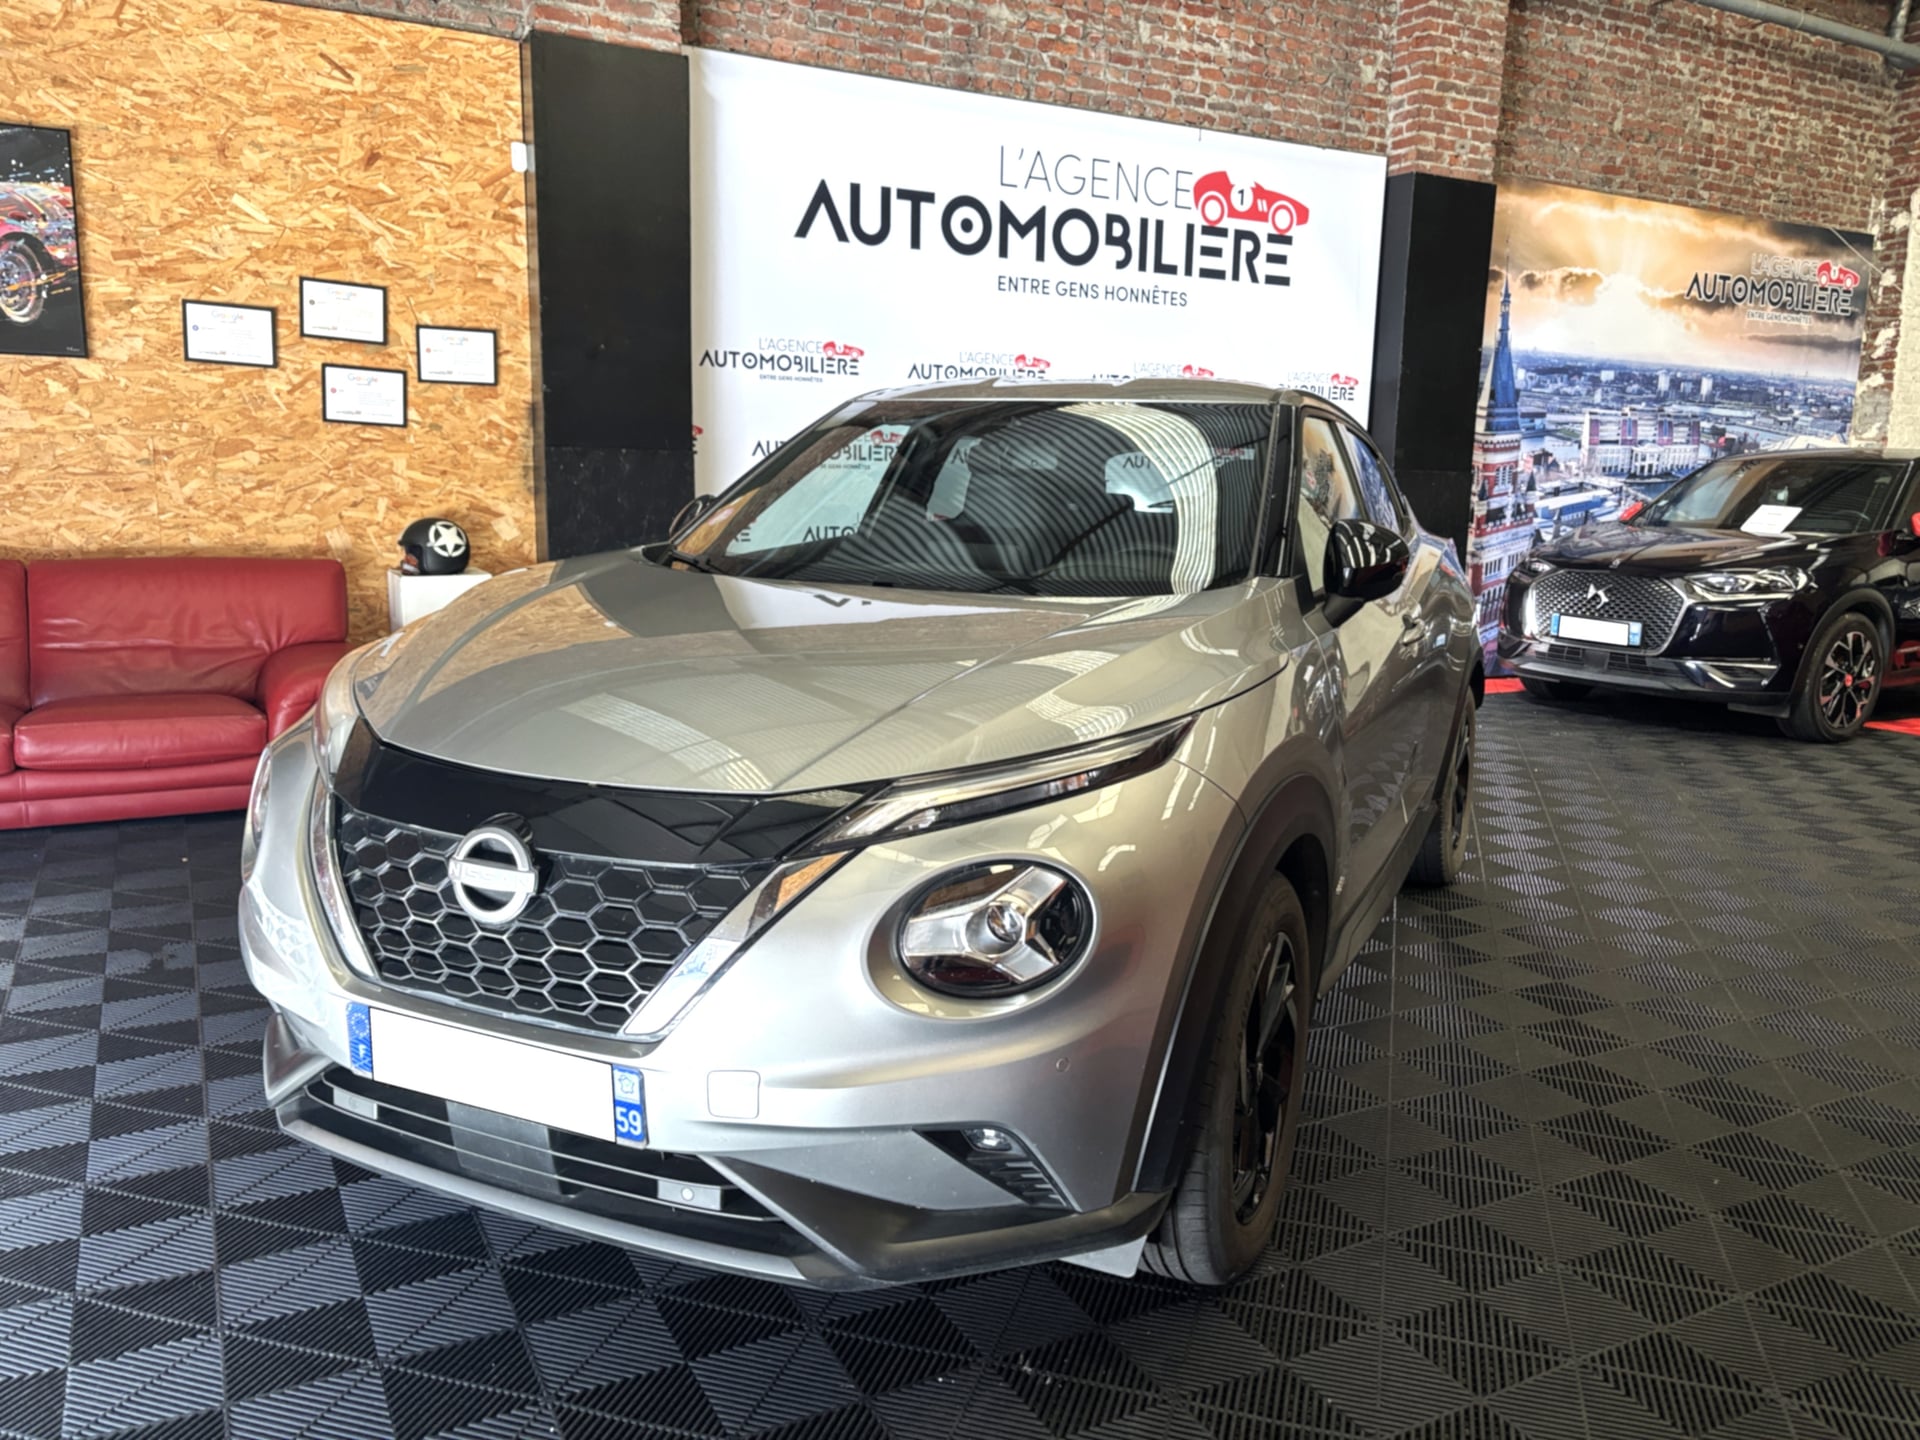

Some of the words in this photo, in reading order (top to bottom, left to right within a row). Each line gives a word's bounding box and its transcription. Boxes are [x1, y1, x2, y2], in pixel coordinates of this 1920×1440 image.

[1001, 145, 1193, 210] L'AGENCE
[1237, 188, 1245, 206] 1
[794, 178, 1292, 287] AUTOMOBILIERE
[998, 275, 1051, 295] ENTRE
[1055, 280, 1099, 299] GENS
[1104, 285, 1188, 307] HONNÊTES
[1685, 271, 1853, 314] AUTOMOBILIERE
[759, 337, 823, 354] L'AGENCE
[699, 349, 859, 376] AUTOMOBILIERE
[616, 1106, 642, 1136] 59
